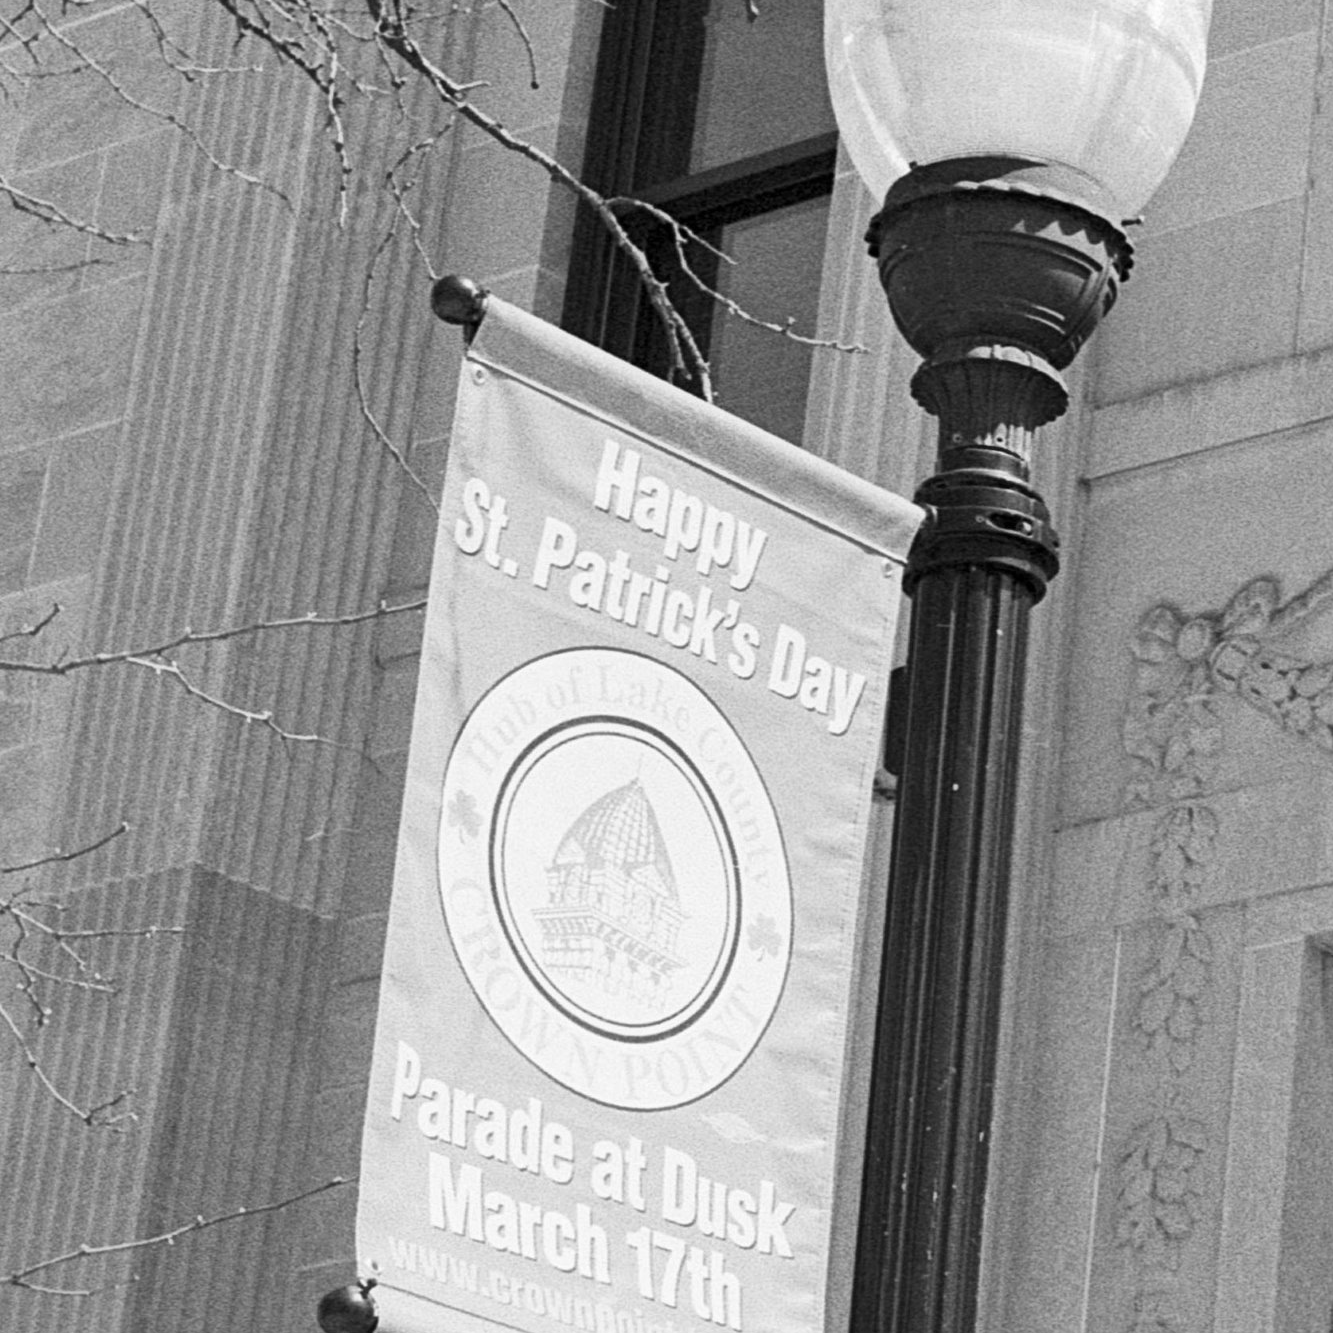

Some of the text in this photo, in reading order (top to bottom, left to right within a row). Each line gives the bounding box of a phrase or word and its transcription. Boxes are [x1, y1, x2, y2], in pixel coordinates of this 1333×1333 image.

[453, 476, 867, 735] St. Patrick's Day
[592, 439, 769, 591] Happy
[465, 663, 773, 890] Hub of Lake County
[448, 876, 763, 1101] CROWN POINT
[392, 1039, 797, 1260] Parade at Dusk
[427, 1152, 743, 1332] March 17th
